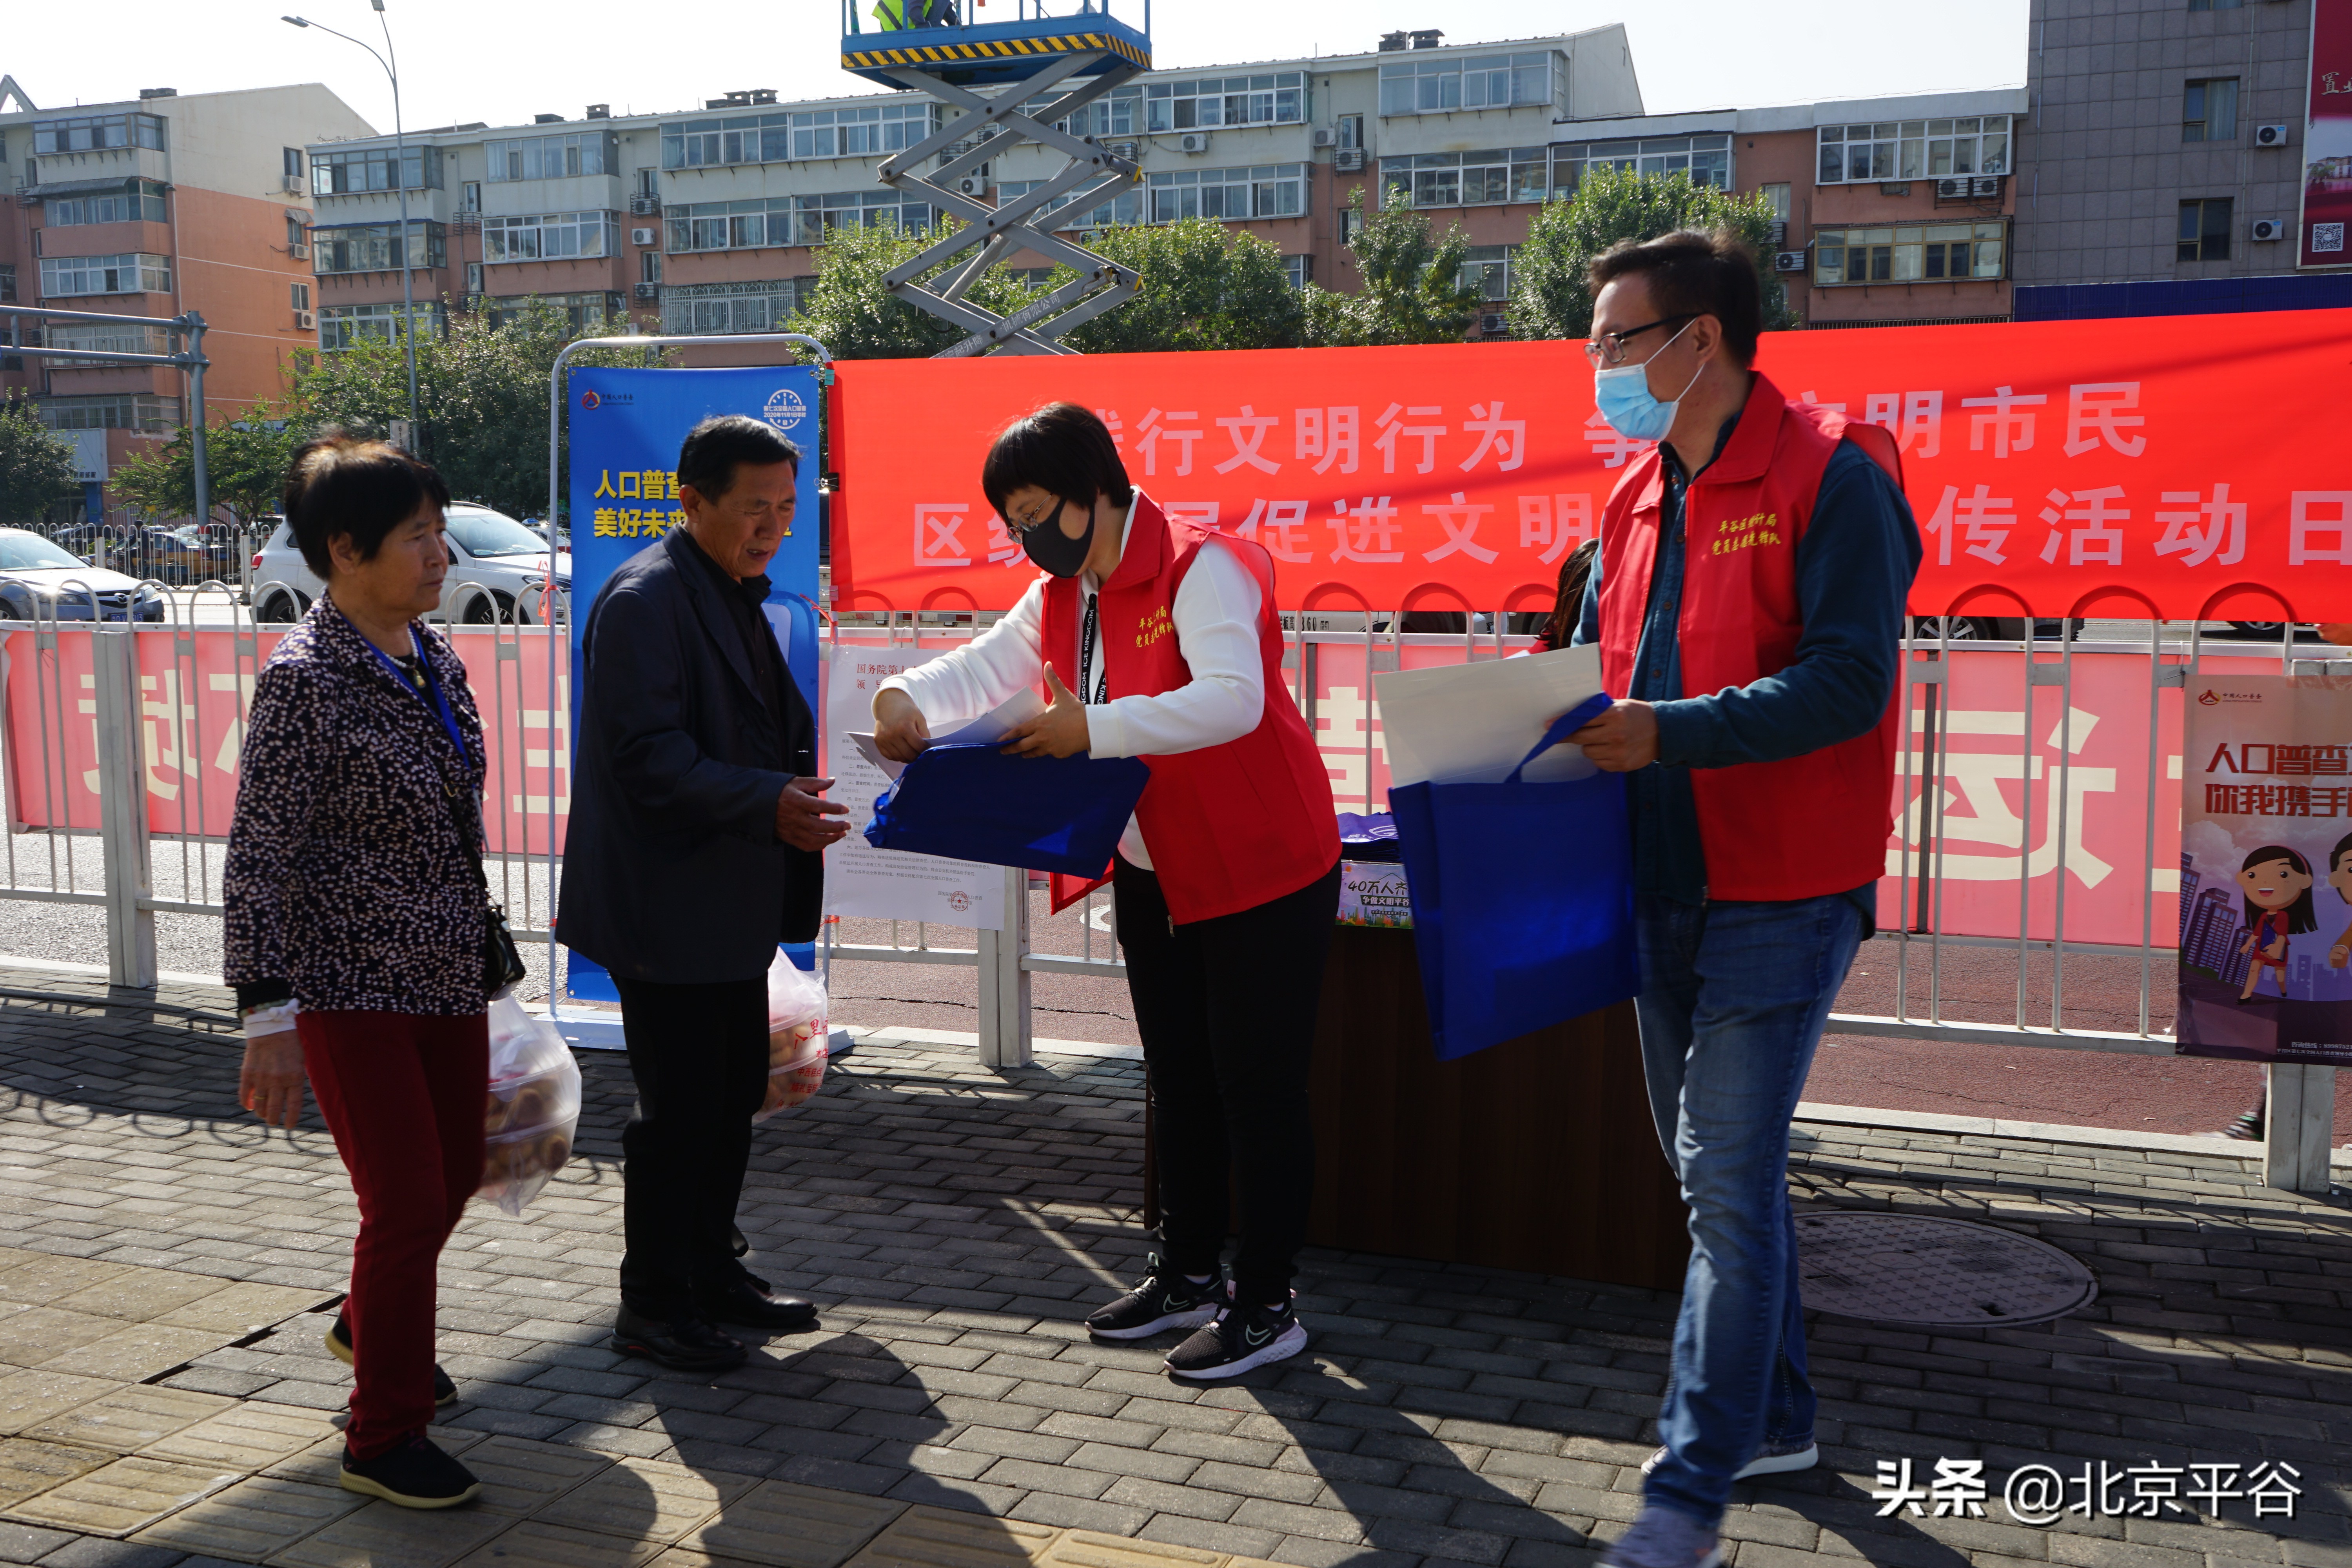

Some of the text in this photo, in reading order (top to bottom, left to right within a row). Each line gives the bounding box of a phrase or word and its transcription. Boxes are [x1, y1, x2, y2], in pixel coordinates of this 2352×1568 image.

[1084, 609, 1094, 651] KINGDOM
[2205, 743, 2352, 775] 人口普查
[2205, 784, 2352, 817] 你我携手
